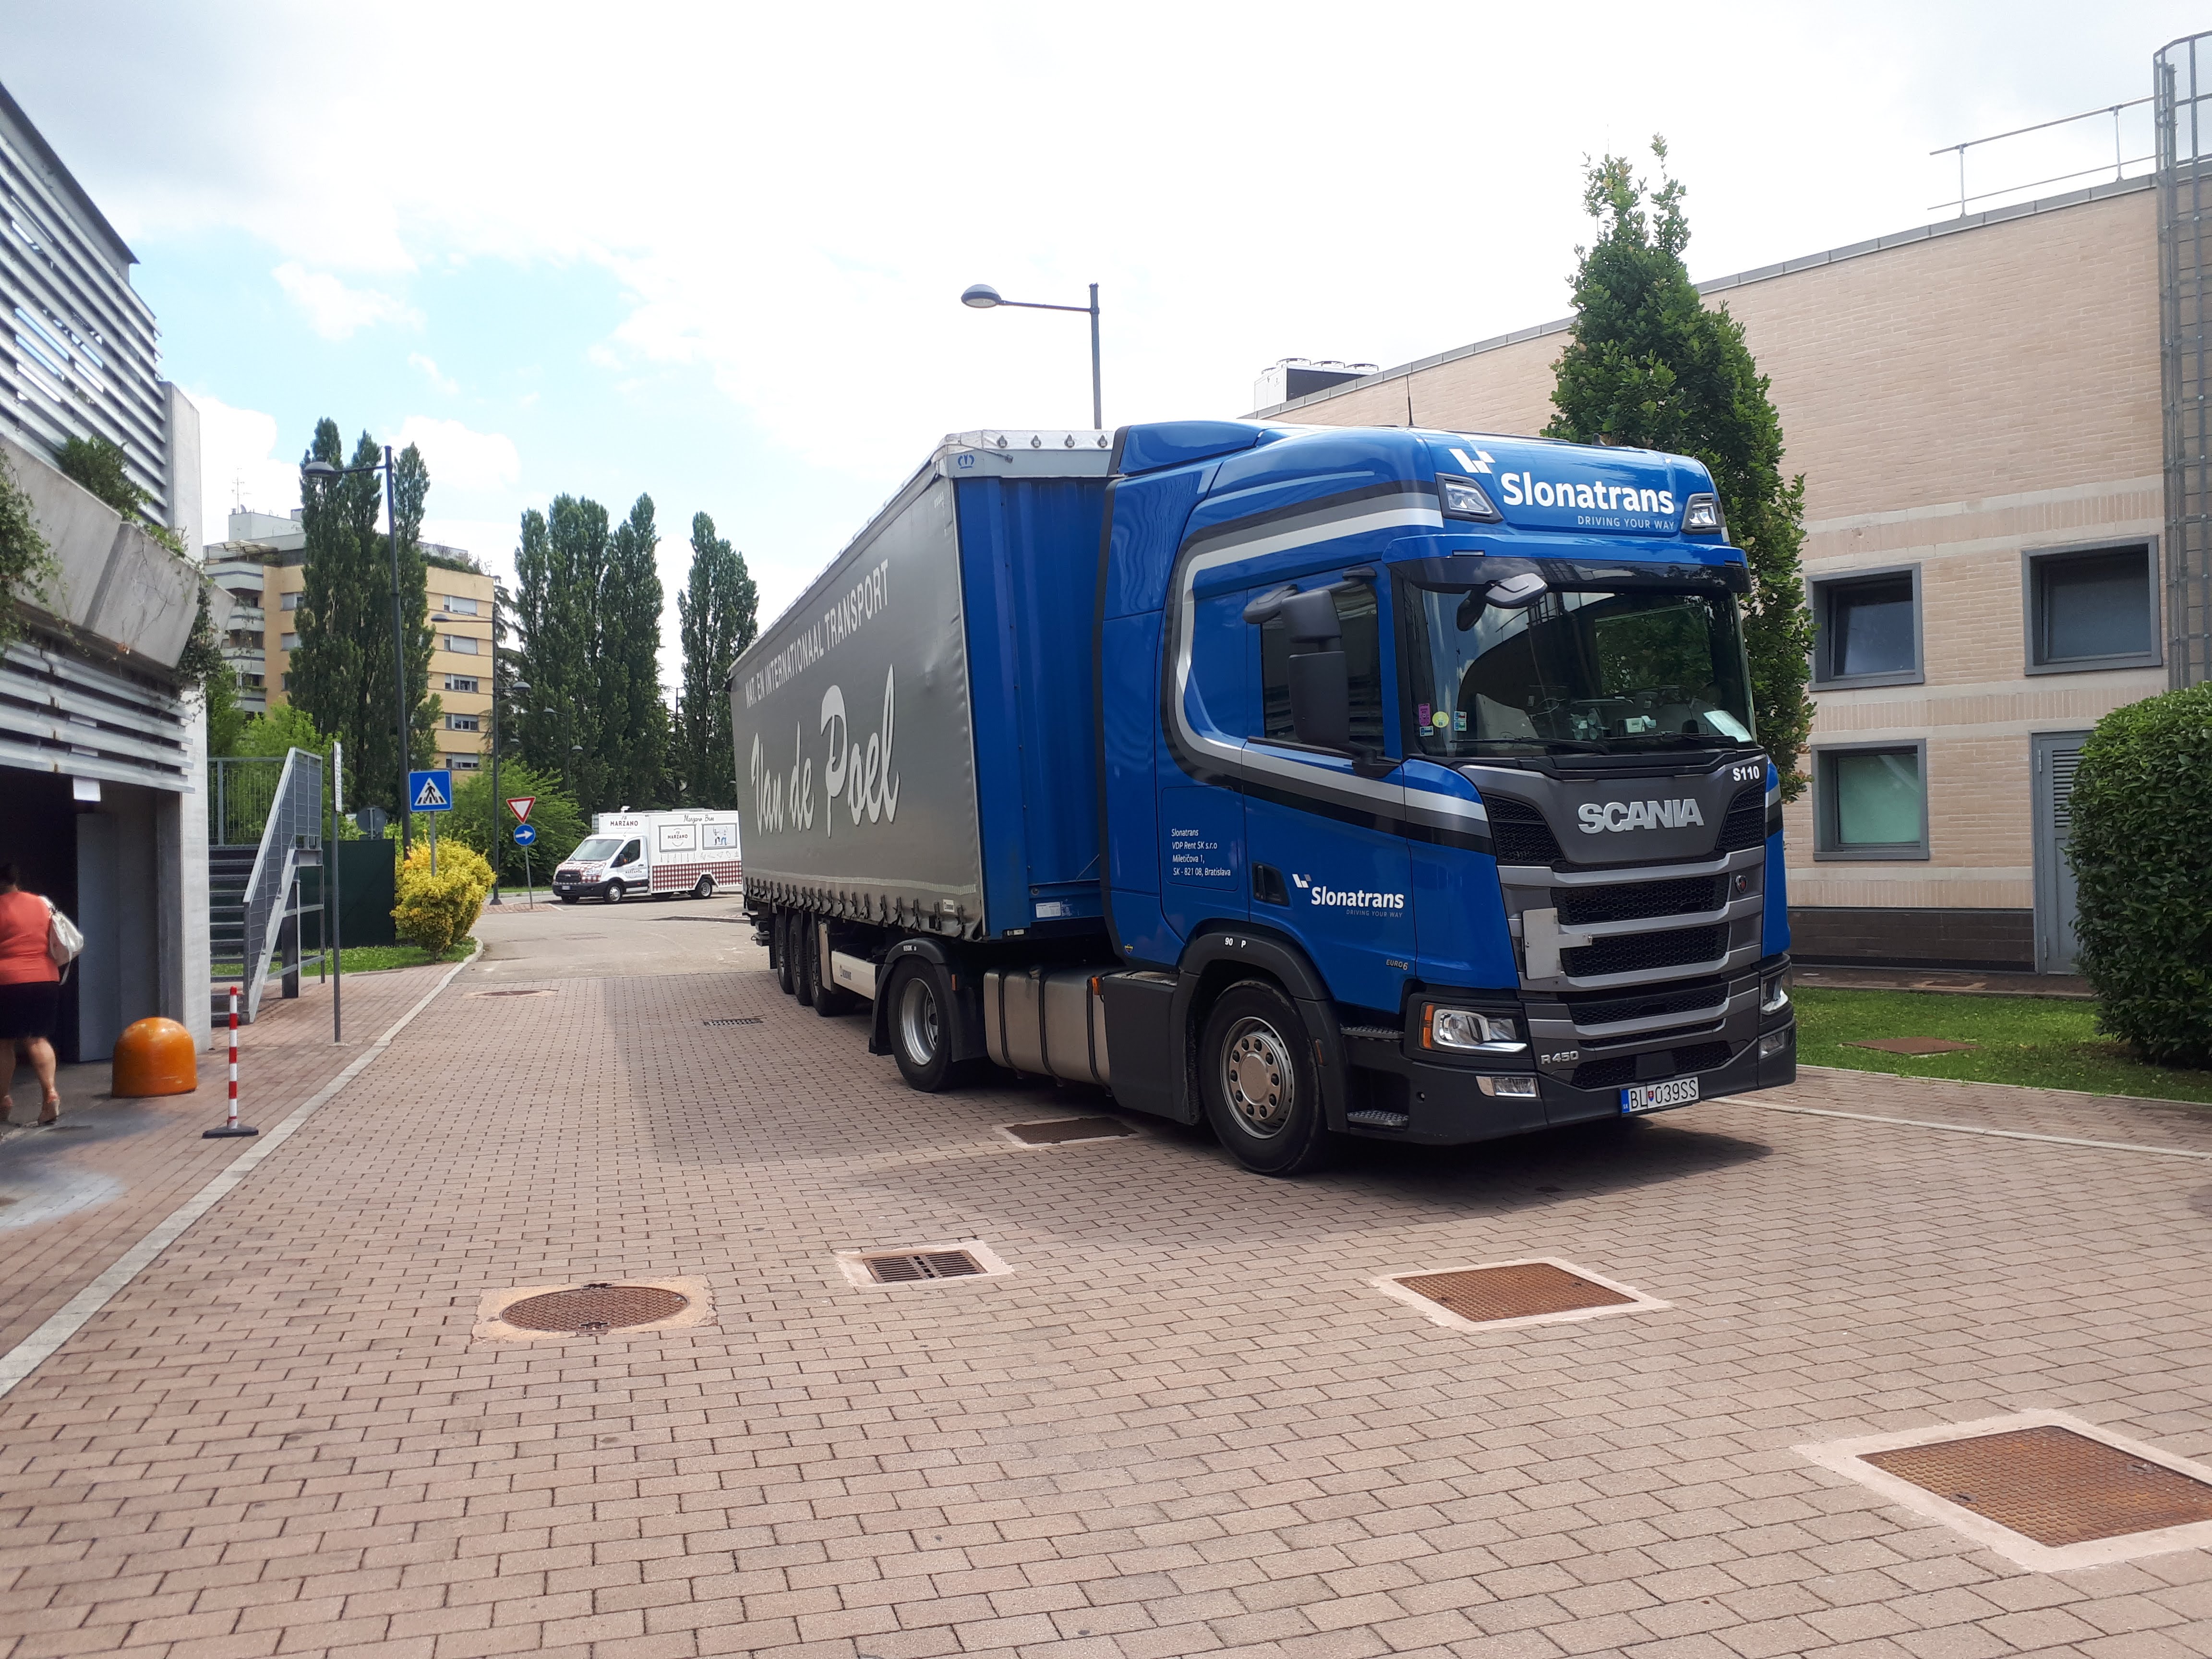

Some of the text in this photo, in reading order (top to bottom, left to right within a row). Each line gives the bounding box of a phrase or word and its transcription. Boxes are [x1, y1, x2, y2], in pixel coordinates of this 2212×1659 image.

[1501, 471, 1675, 515] Slonatrans
[1577, 515, 1674, 530] DRIVING YOUR WAY
[745, 558, 889, 709] NAT. EN INTERNATIONAAL TRANSPORT
[750, 663, 901, 838] Van de Poel
[1732, 766, 1760, 782] S110
[1578, 798, 1705, 834] SCANIA
[1171, 828, 1199, 837] Slonatrans
[1172, 842, 1183, 850] VDP
[1197, 841, 1204, 849] SK
[1173, 854, 1205, 864] Miletičova 1,
[1173, 867, 1180, 876] SK
[1184, 867, 1193, 876] 821
[1195, 867, 1203, 878] 08,
[1205, 867, 1231, 876] Bratislava
[1311, 885, 1404, 909] Slonatrans
[1225, 937, 1246, 948] 90 P
[1540, 1050, 1579, 1065] R 450
[1630, 1080, 1696, 1109] BL 039SS
